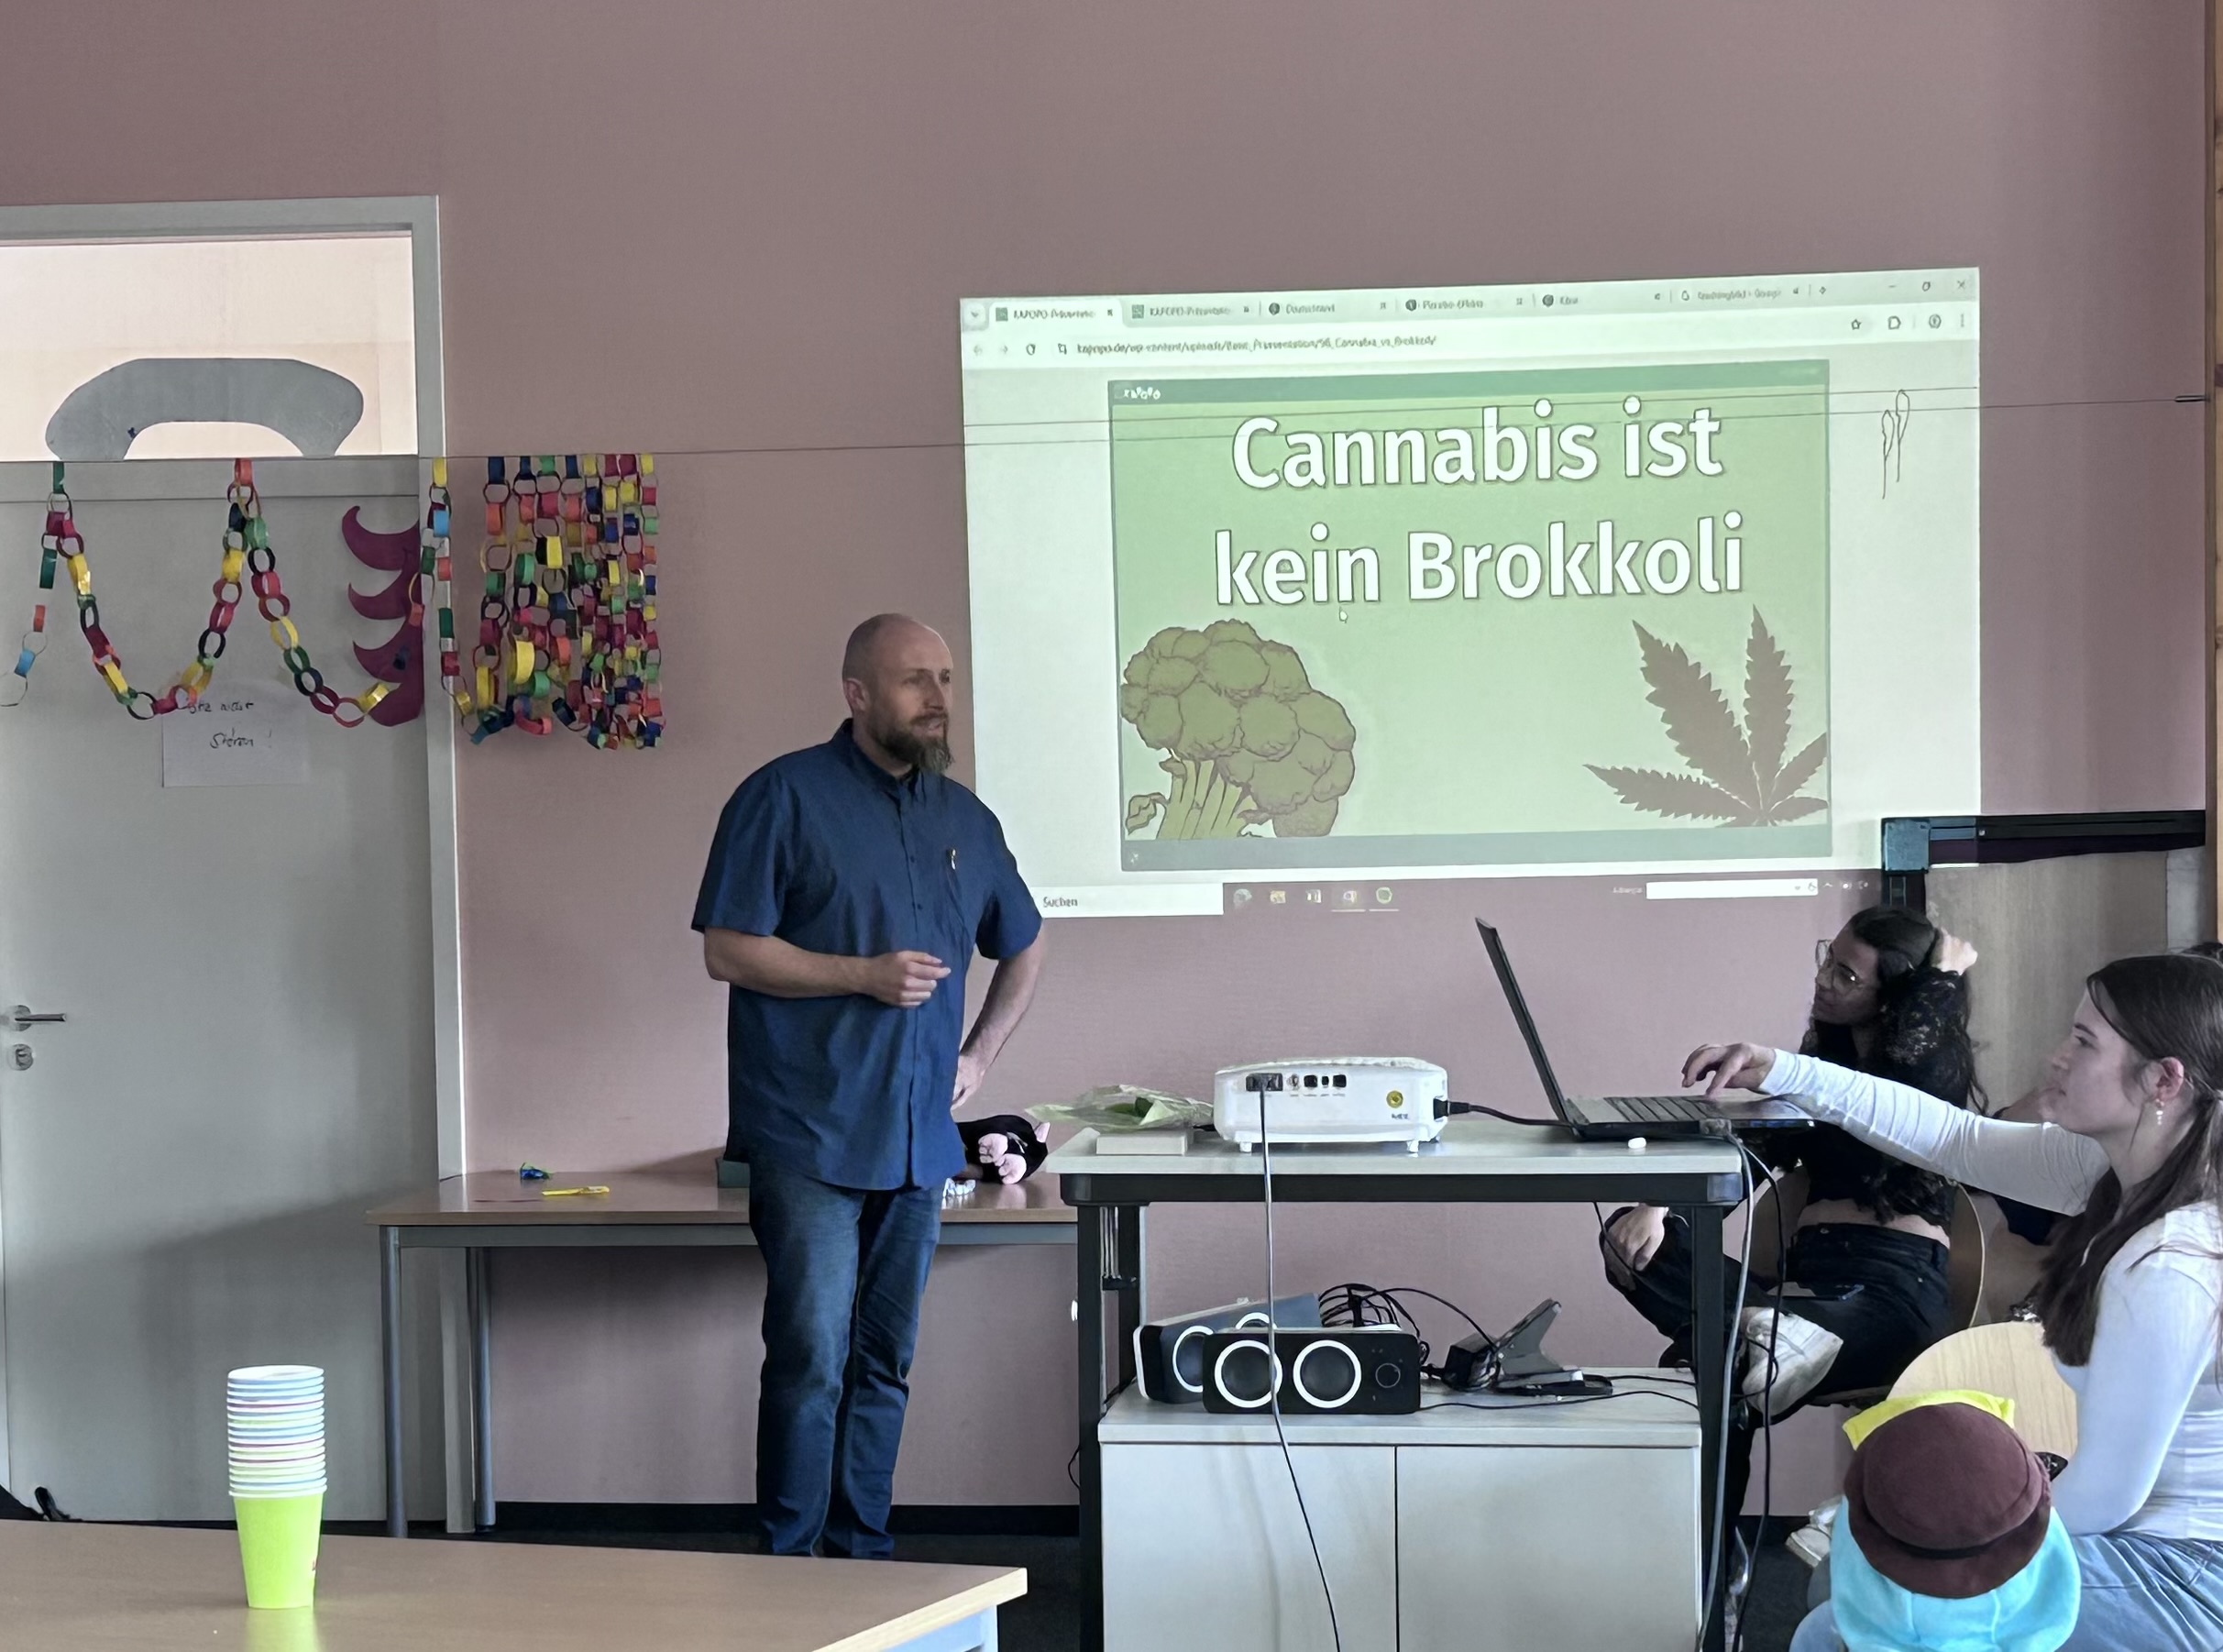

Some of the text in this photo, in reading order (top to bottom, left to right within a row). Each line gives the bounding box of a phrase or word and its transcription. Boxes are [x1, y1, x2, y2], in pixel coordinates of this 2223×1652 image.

[1231, 395, 1723, 489] Cannabis ist
[1215, 510, 1743, 606] kein Brokkoli
[1043, 896, 1078, 908] Suchen
